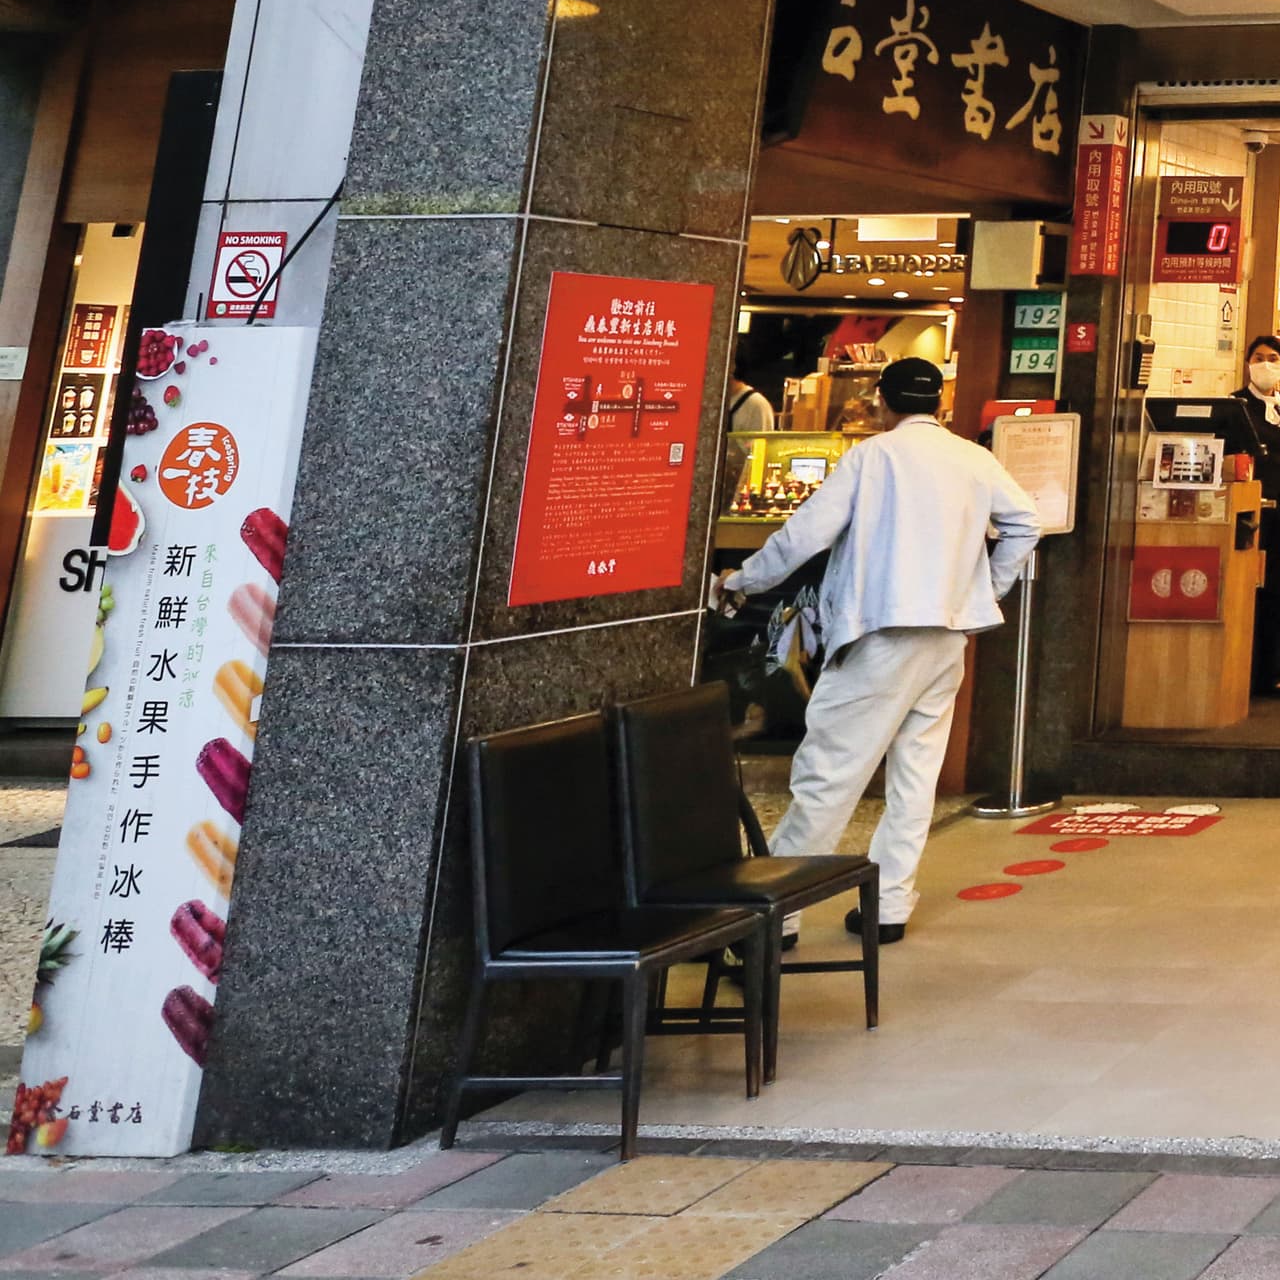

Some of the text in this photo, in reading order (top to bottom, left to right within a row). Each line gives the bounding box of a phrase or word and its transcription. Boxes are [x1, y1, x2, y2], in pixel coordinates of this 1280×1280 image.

[225, 235, 282, 245] NO SMOKING
[1019, 308, 1060, 325] 192
[1015, 352, 1056, 370] 194
[222, 434, 237, 482] IceSpring
[100, 544, 198, 954] 新鮮水果手作冰棒
